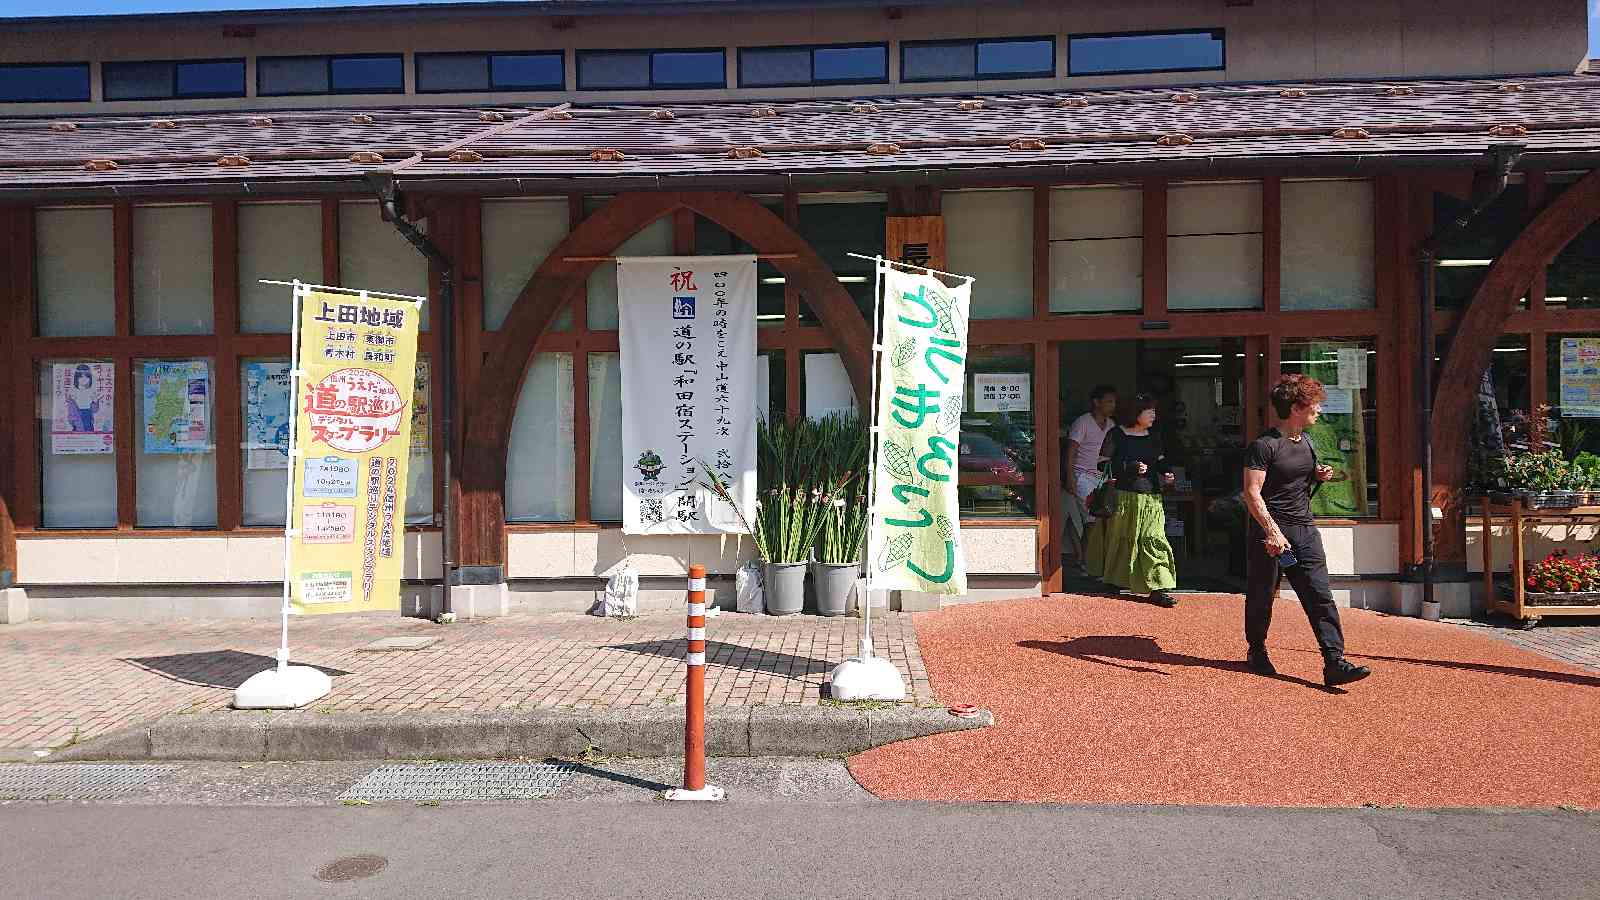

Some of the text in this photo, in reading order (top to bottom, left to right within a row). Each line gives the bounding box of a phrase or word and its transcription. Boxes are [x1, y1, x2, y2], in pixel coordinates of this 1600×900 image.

[670, 266, 698, 292] 祝
[314, 301, 404, 328] 上田地域
[325, 331, 357, 342] 上田市
[364, 335, 397, 348] 東御市
[325, 348, 356, 359] 青木村
[363, 351, 396, 364] 長和町
[347, 369, 372, 377] 2024
[303, 382, 401, 417] 道の駅巡り
[317, 415, 355, 425] デジタル
[310, 425, 401, 443] スタンプラリー
[363, 457, 382, 600] 道の駅巡りデジタルスタンプラリー
